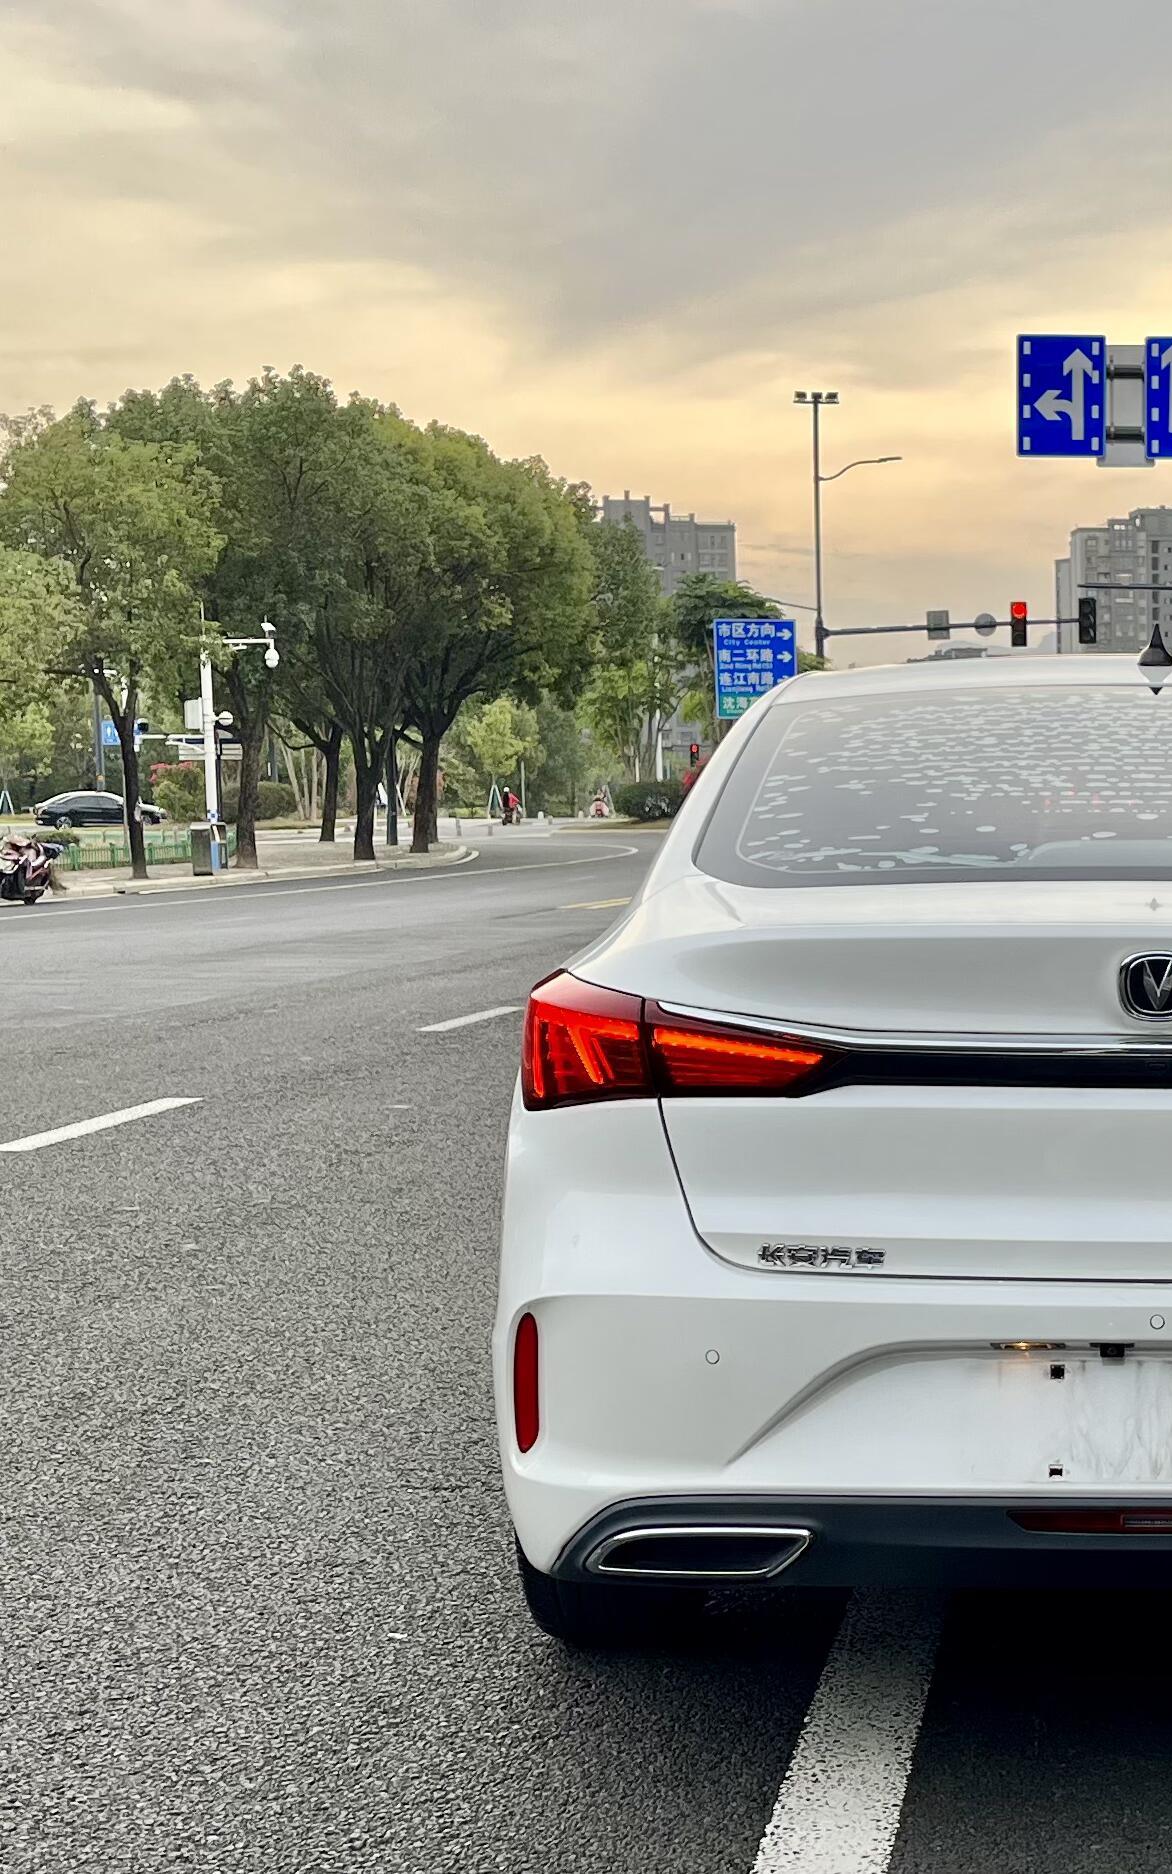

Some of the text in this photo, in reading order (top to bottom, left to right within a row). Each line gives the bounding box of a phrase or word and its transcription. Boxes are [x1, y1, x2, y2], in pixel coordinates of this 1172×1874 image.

[718, 622, 776, 638] 市区方向
[718, 648, 774, 663] 南二环路
[719, 671, 774, 686] 连江南路
[757, 1242, 886, 1270] 长安汽车
